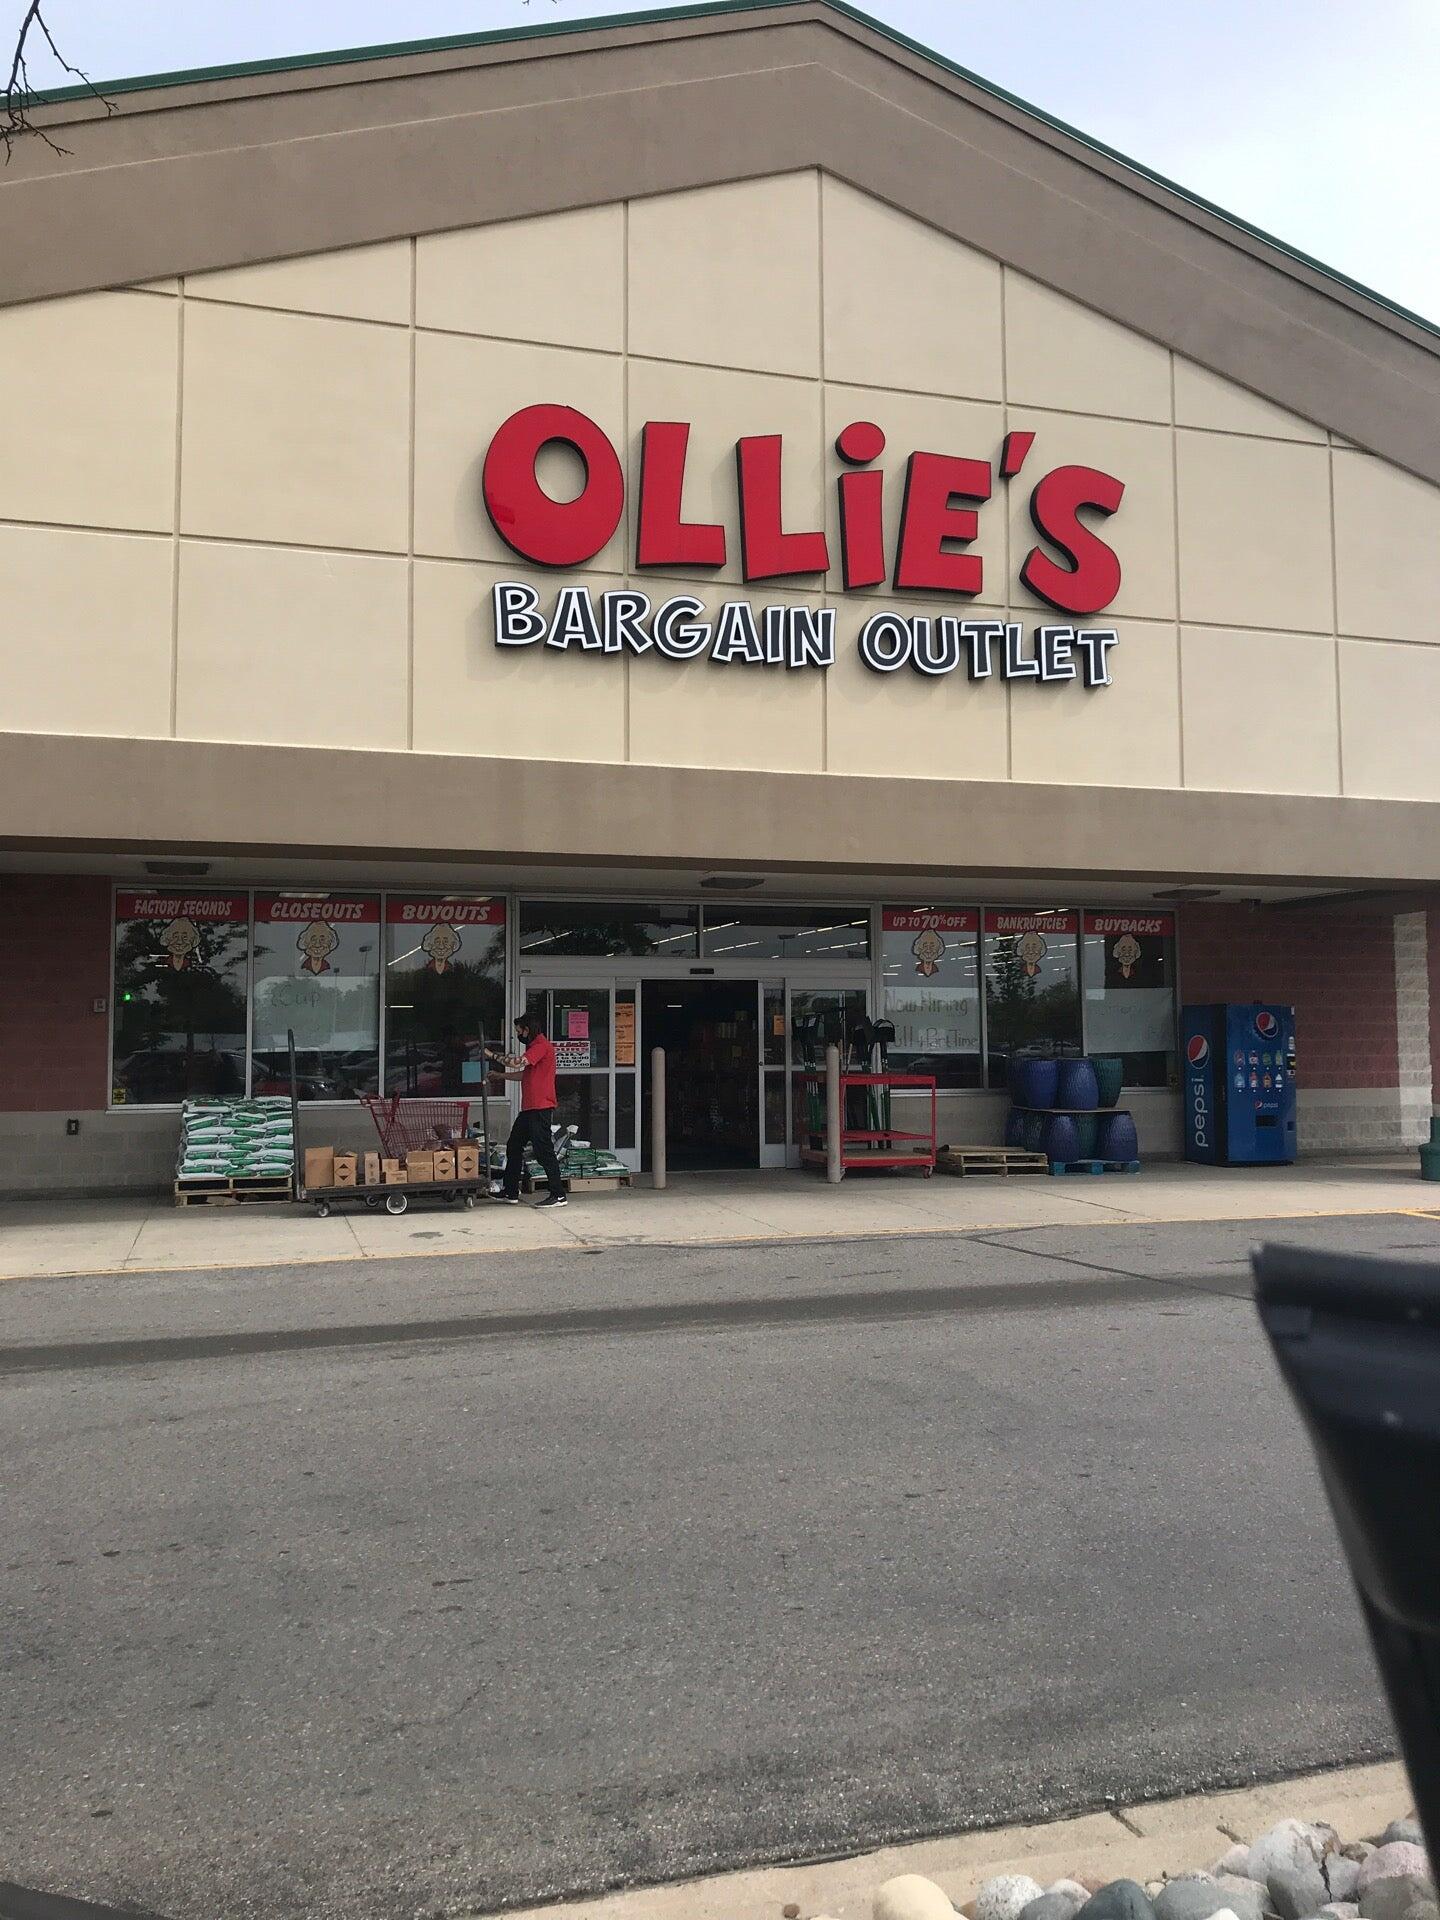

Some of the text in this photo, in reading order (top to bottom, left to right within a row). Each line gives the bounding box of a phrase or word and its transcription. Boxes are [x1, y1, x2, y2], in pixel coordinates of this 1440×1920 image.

[493, 580, 1120, 687] BARGAIN OUTLET
[134, 899, 233, 916] FACTORY SECONDS
[270, 902, 364, 920] CLOSEOUTS
[402, 904, 490, 922] BUYOUTS
[892, 914, 967, 929] UP TO 70% OFF
[997, 916, 1067, 931] BANKRUPTCIES
[1094, 918, 1163, 933] BUYBACKS
[1191, 1074, 1209, 1148] pepsi
